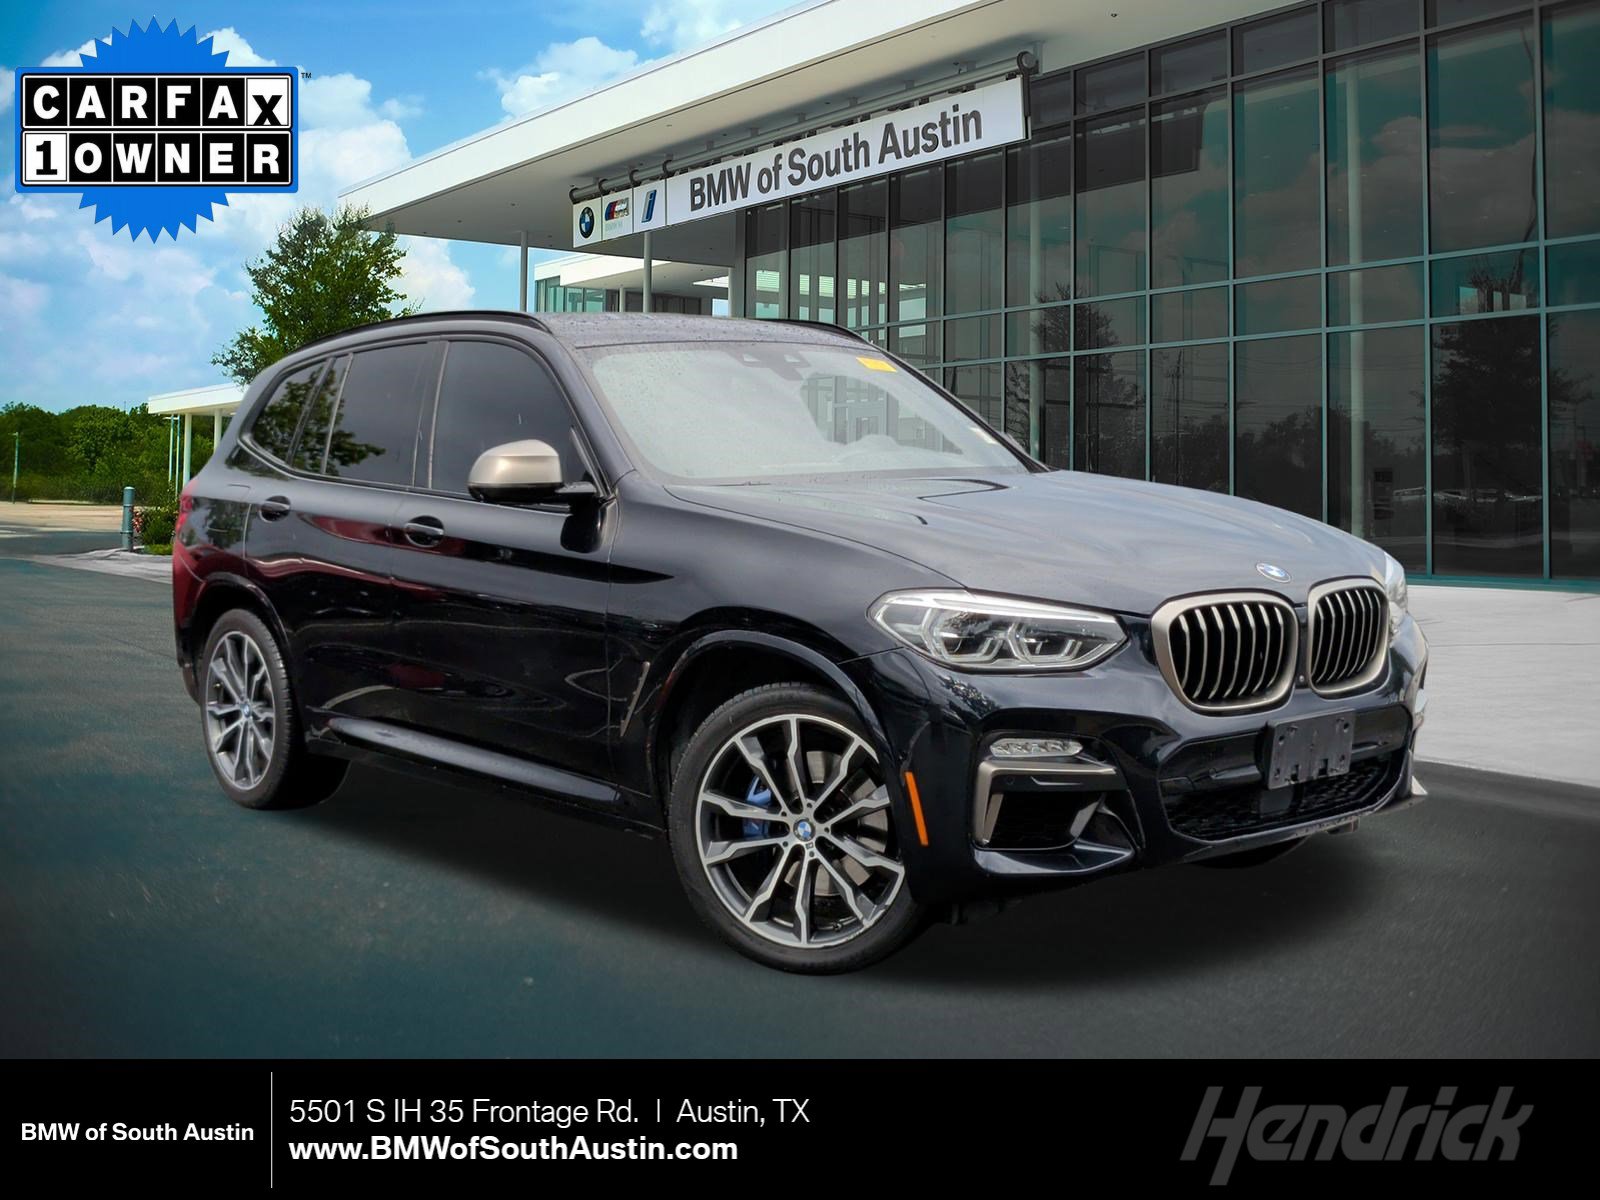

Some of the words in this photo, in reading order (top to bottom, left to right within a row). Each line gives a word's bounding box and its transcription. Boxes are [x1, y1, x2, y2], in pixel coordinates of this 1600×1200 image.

[690, 162, 752, 212] BMW
[757, 153, 783, 194] of
[787, 131, 871, 187] South
[878, 103, 983, 165] Austin
